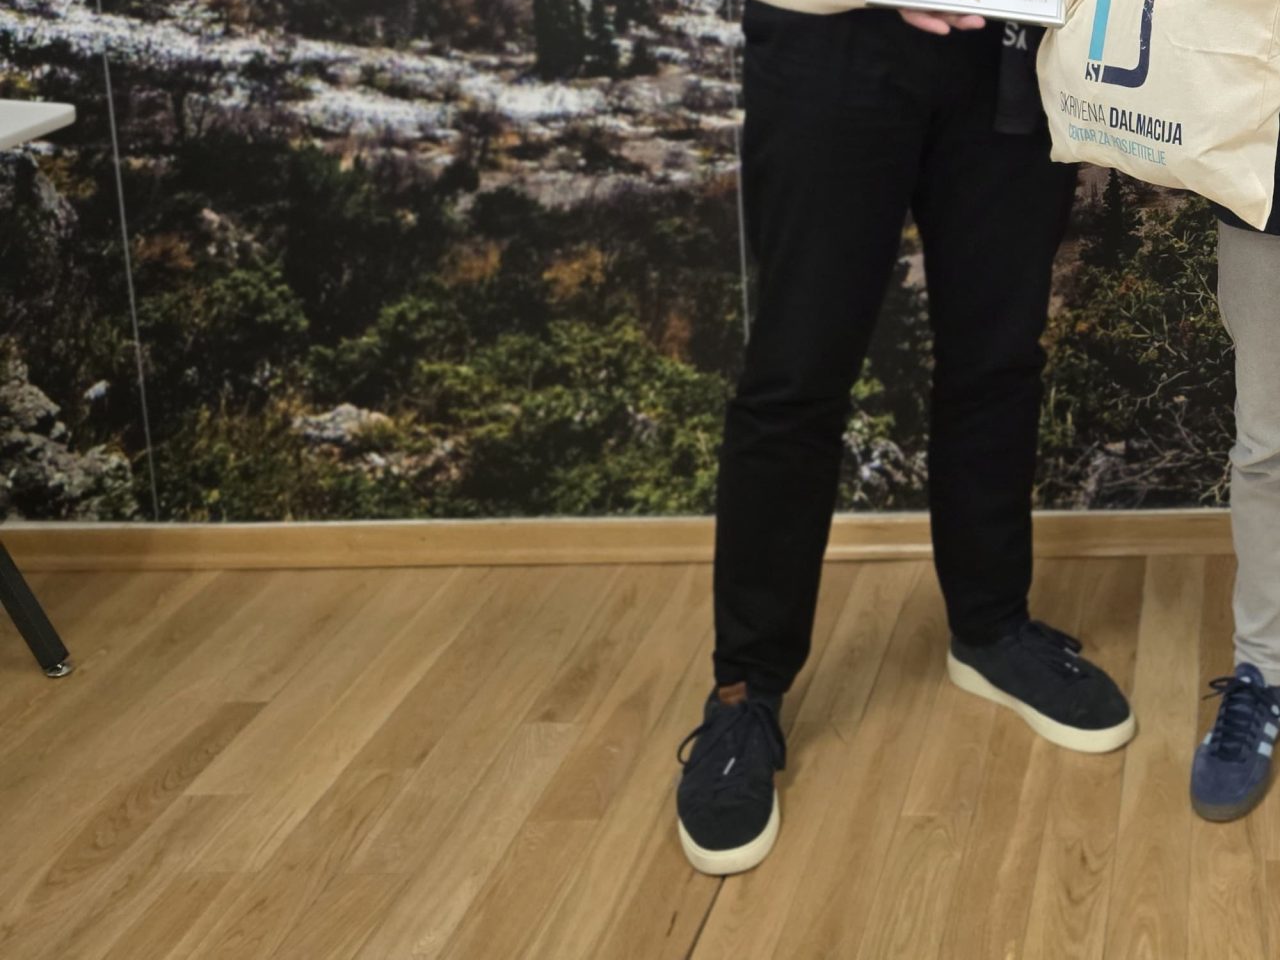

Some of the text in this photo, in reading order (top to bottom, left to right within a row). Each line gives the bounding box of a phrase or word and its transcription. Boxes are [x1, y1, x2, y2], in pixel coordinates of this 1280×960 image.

[1060, 90, 1183, 146] SKRIVENA DALMACIJA
[1068, 122, 1167, 166] CENTAR ZA POSJETITELJE
